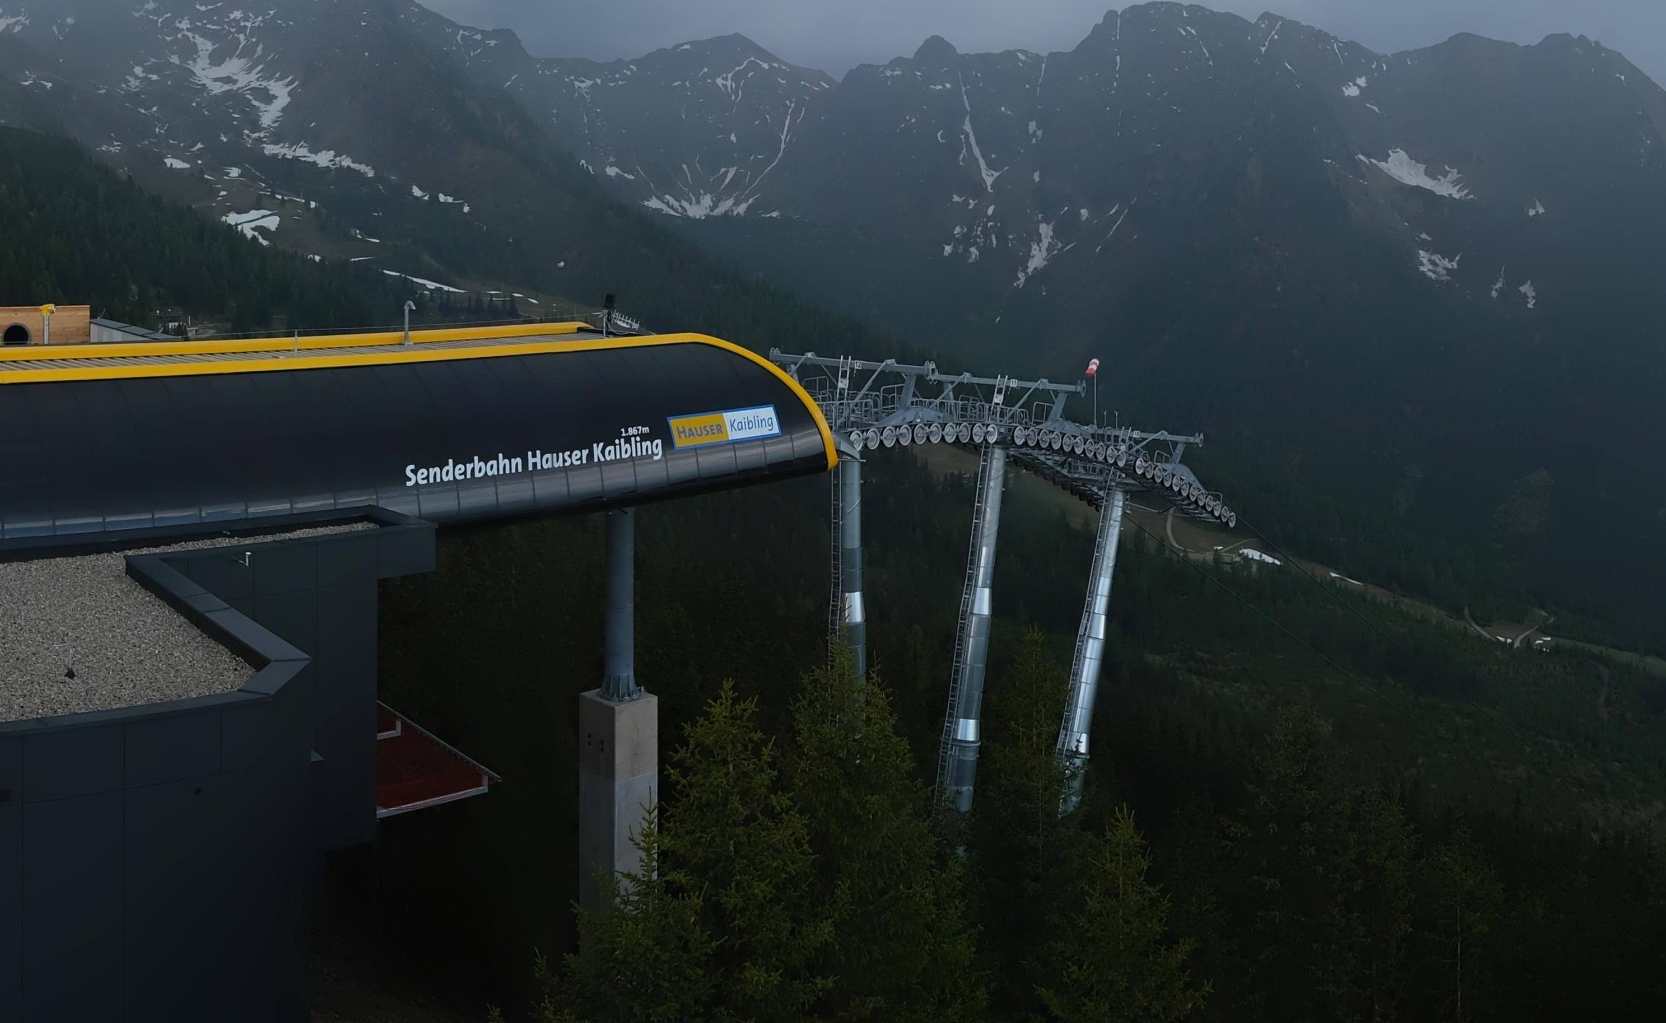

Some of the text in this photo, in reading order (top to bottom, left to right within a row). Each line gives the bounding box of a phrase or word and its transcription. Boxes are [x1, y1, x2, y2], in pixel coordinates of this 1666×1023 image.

[621, 426, 649, 437] 1.867m
[677, 415, 774, 440] HAUSER Kaibling
[405, 437, 662, 487] Senderbahn Hauser Kaibling
